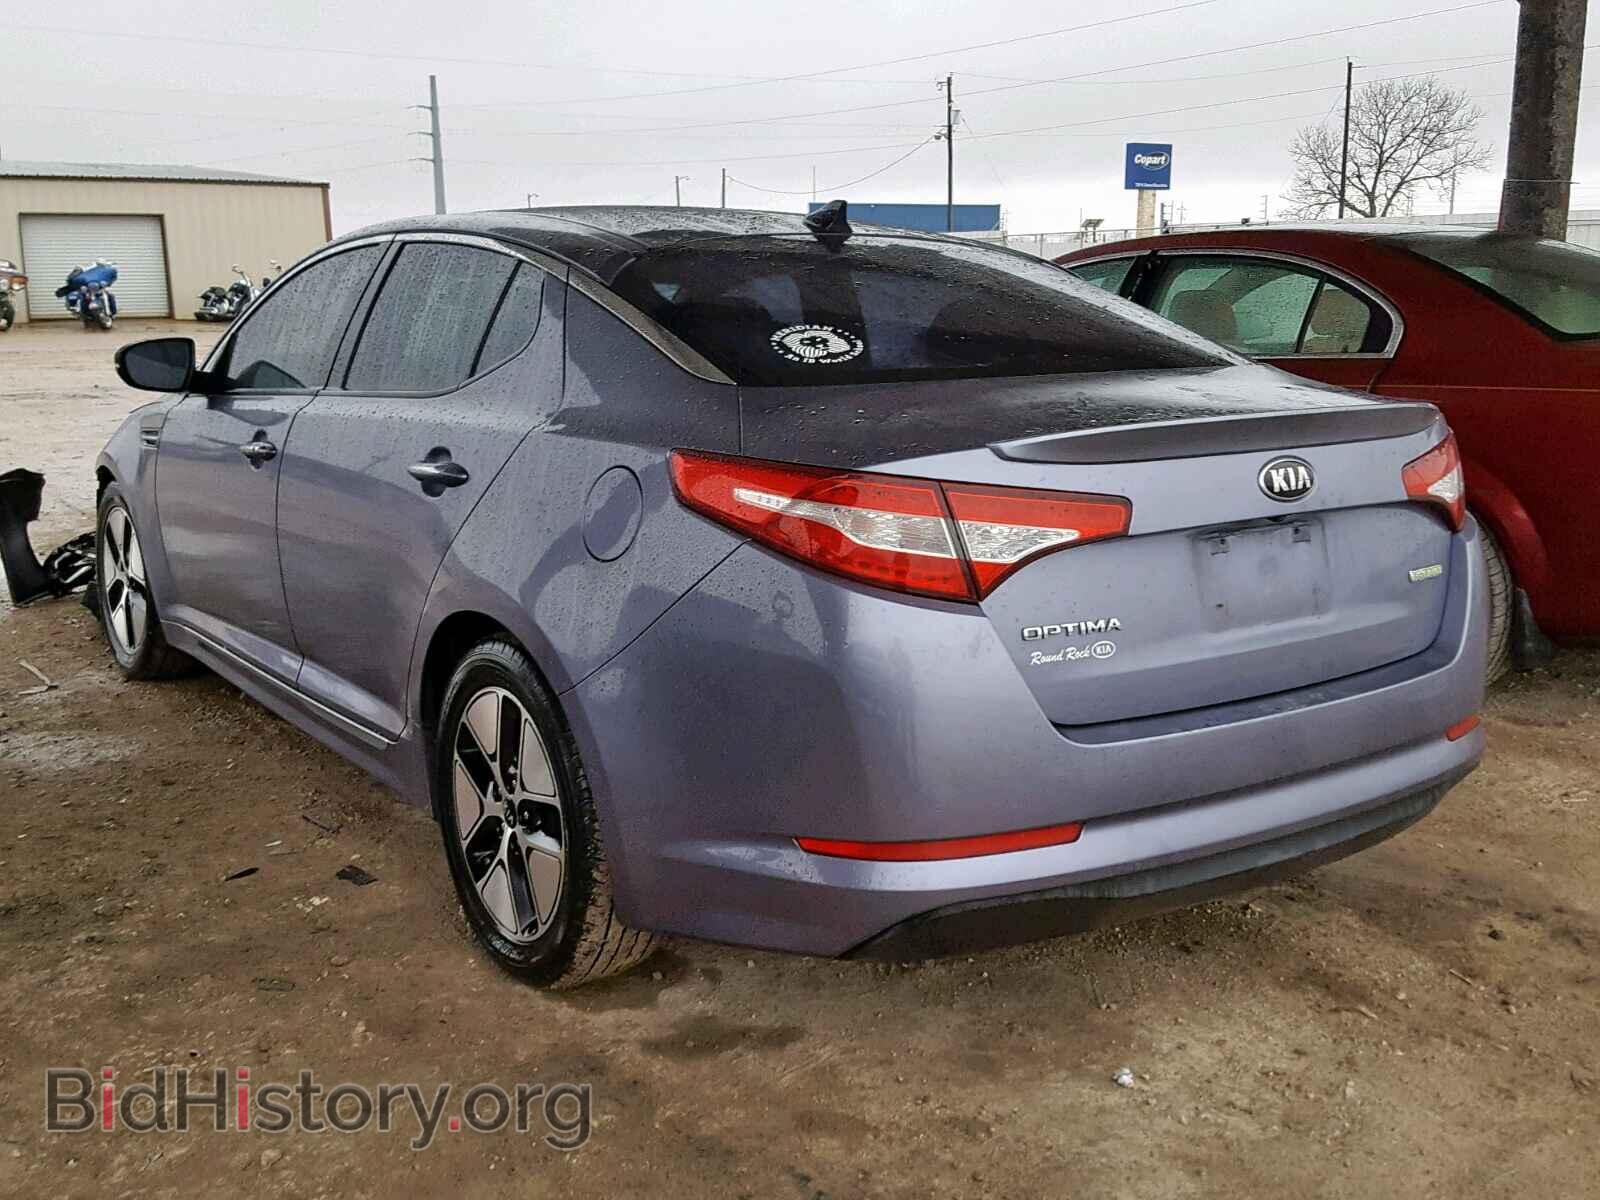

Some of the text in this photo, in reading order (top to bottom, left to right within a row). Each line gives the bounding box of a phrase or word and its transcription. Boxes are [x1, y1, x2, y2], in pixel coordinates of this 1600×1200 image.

[1134, 153, 1166, 166] Copart
[1269, 466, 1311, 493] KIA
[1022, 618, 1121, 641] OPTIMA
[1030, 648, 1064, 665] Round
[1065, 644, 1091, 661] Rock
